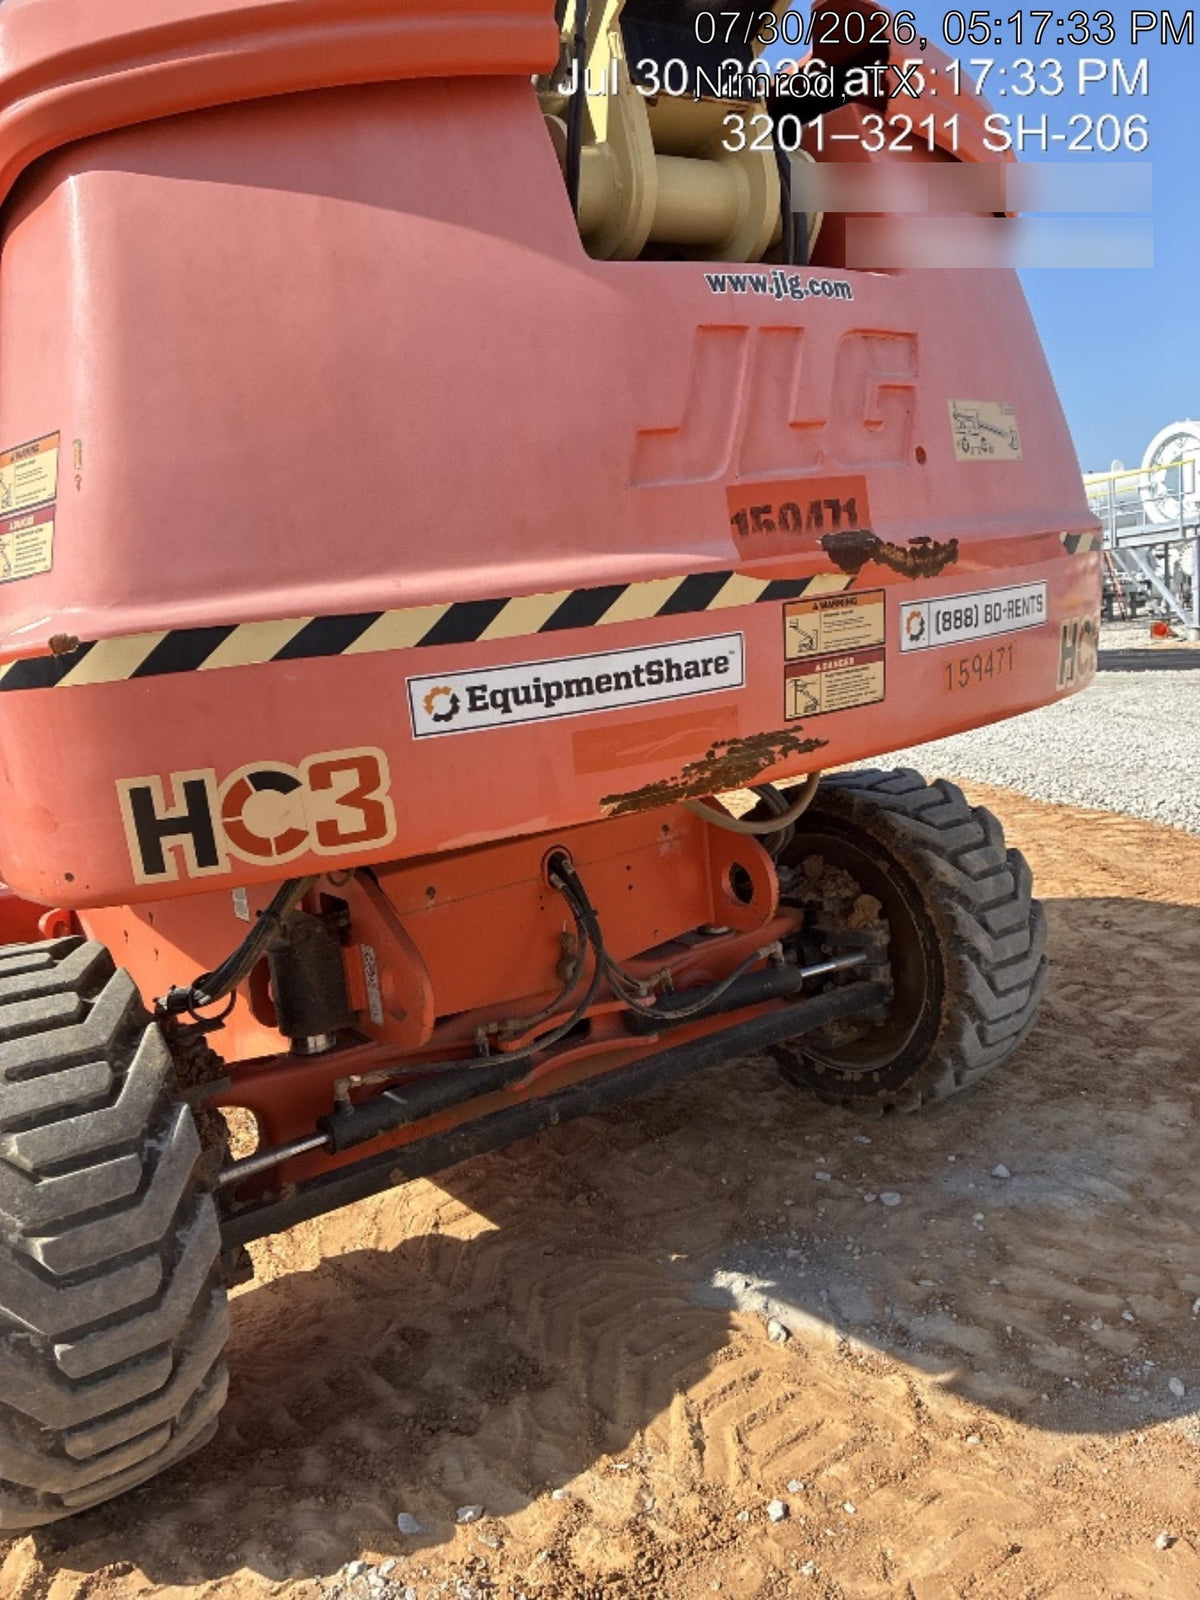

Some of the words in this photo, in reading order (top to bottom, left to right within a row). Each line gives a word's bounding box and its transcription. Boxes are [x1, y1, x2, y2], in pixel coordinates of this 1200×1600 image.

[705, 270, 853, 300] www.jlg.com
[627, 324, 918, 488] JLG
[936, 604, 979, 635] (888)
[465, 653, 730, 714] EquipmentShare
[945, 644, 1014, 691] 159471
[128, 754, 388, 876] HC3
